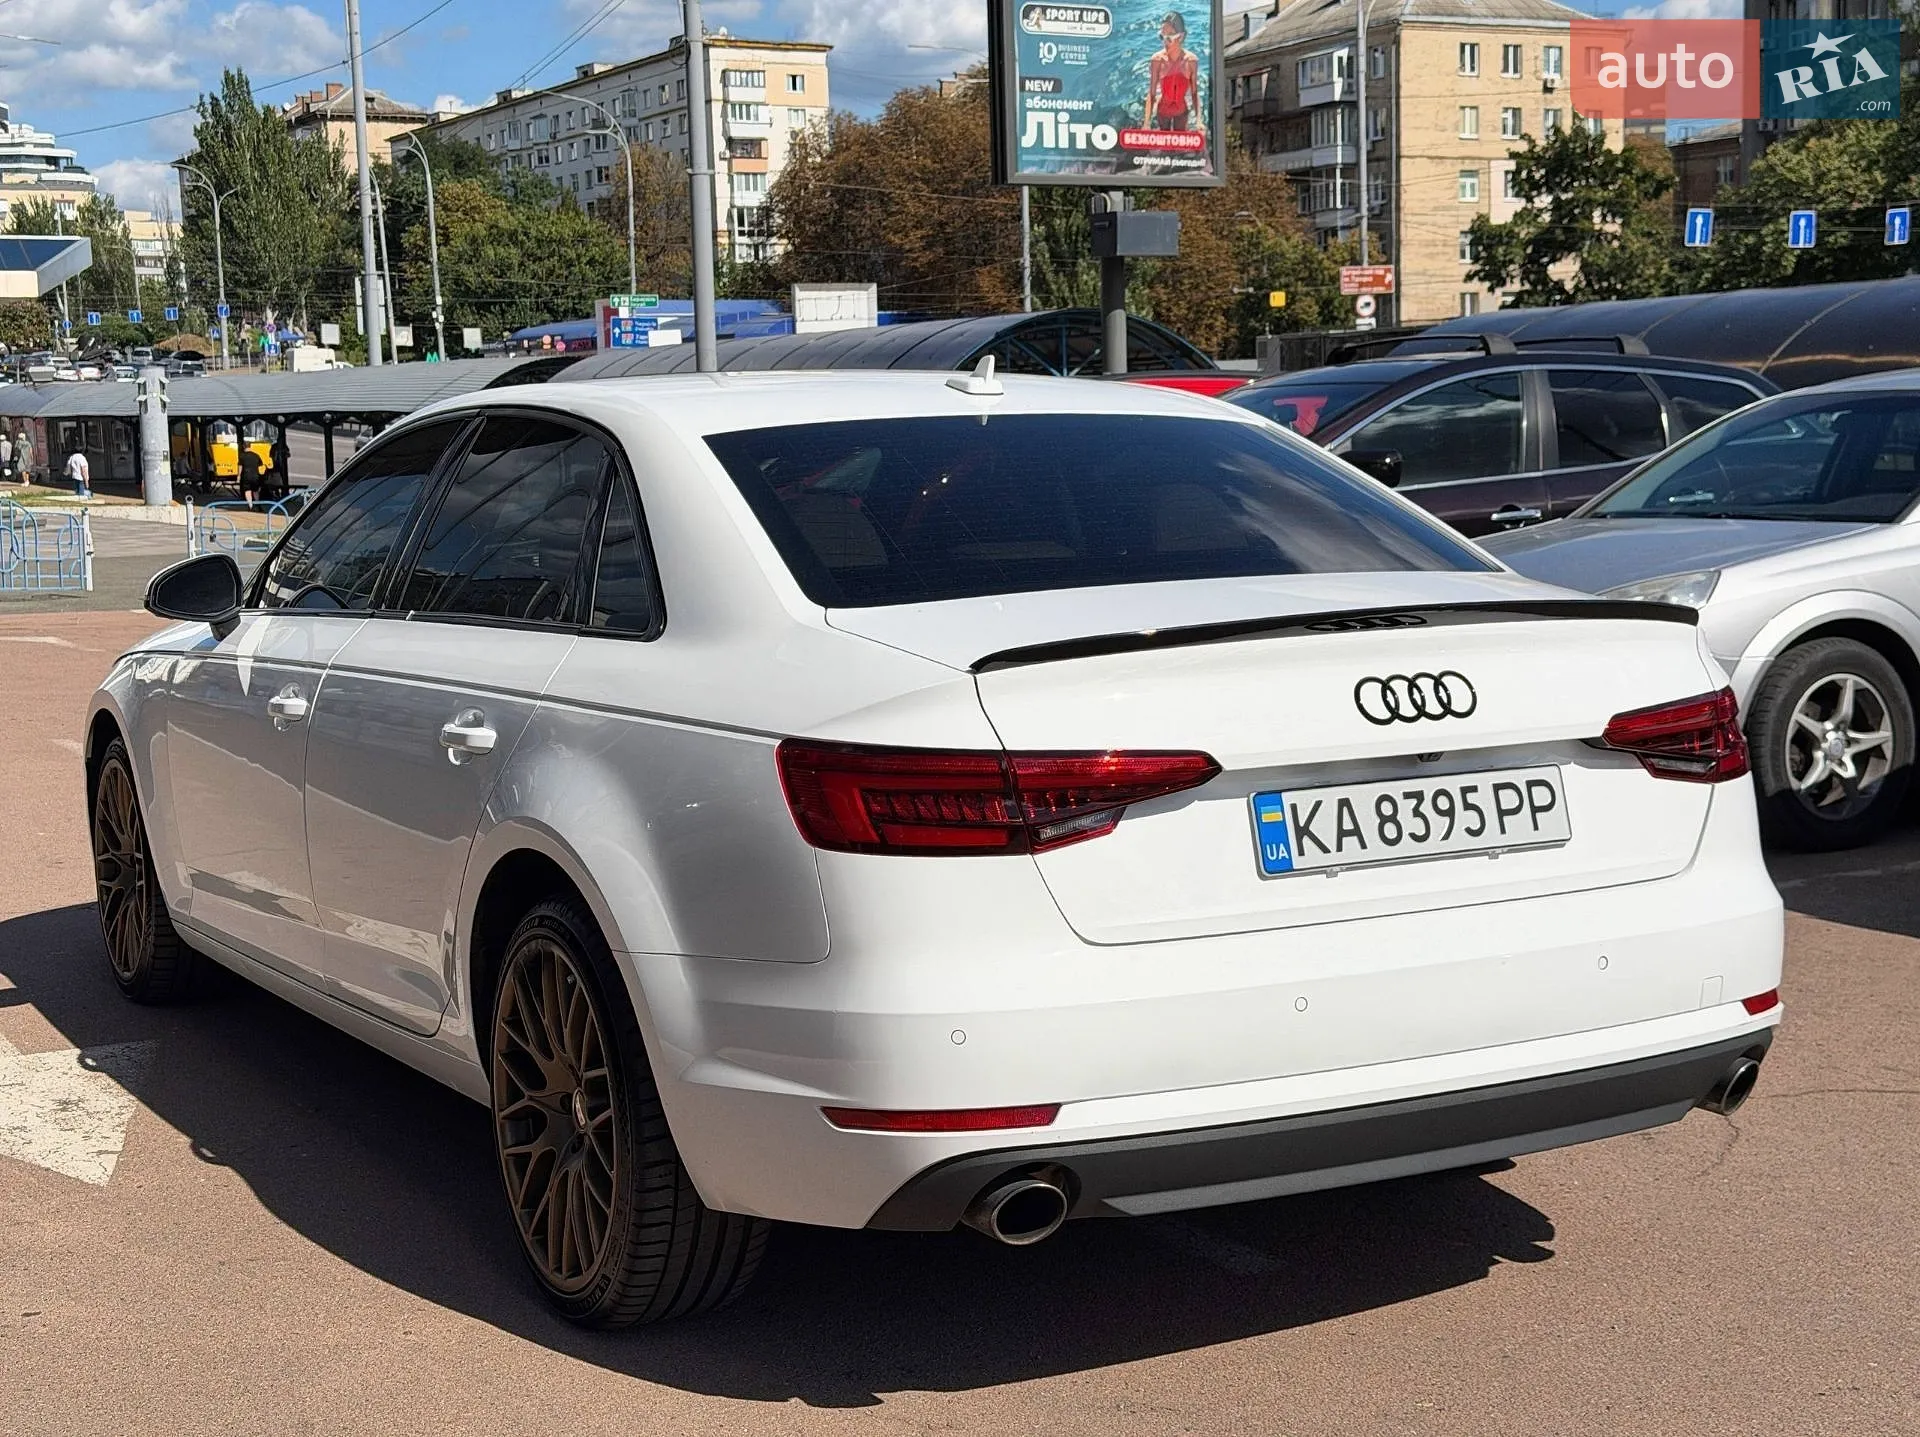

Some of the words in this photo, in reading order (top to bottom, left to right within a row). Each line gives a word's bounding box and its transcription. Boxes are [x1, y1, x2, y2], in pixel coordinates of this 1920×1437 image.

[1045, 8, 1081, 22] SPORT
[1082, 11, 1105, 23] LIFE
[1058, 44, 1090, 53] BUSINESS
[1060, 52, 1087, 61] CENTER
[1025, 79, 1053, 92] NEW
[1025, 97, 1094, 111] абонемент
[1021, 111, 1118, 150] Літо
[1124, 132, 1202, 148] БЕЗКОШТОВНО
[1290, 798, 1368, 857] KA
[1375, 784, 1487, 848] 8395
[1492, 778, 1556, 835] PP
[1266, 843, 1289, 861] UA
